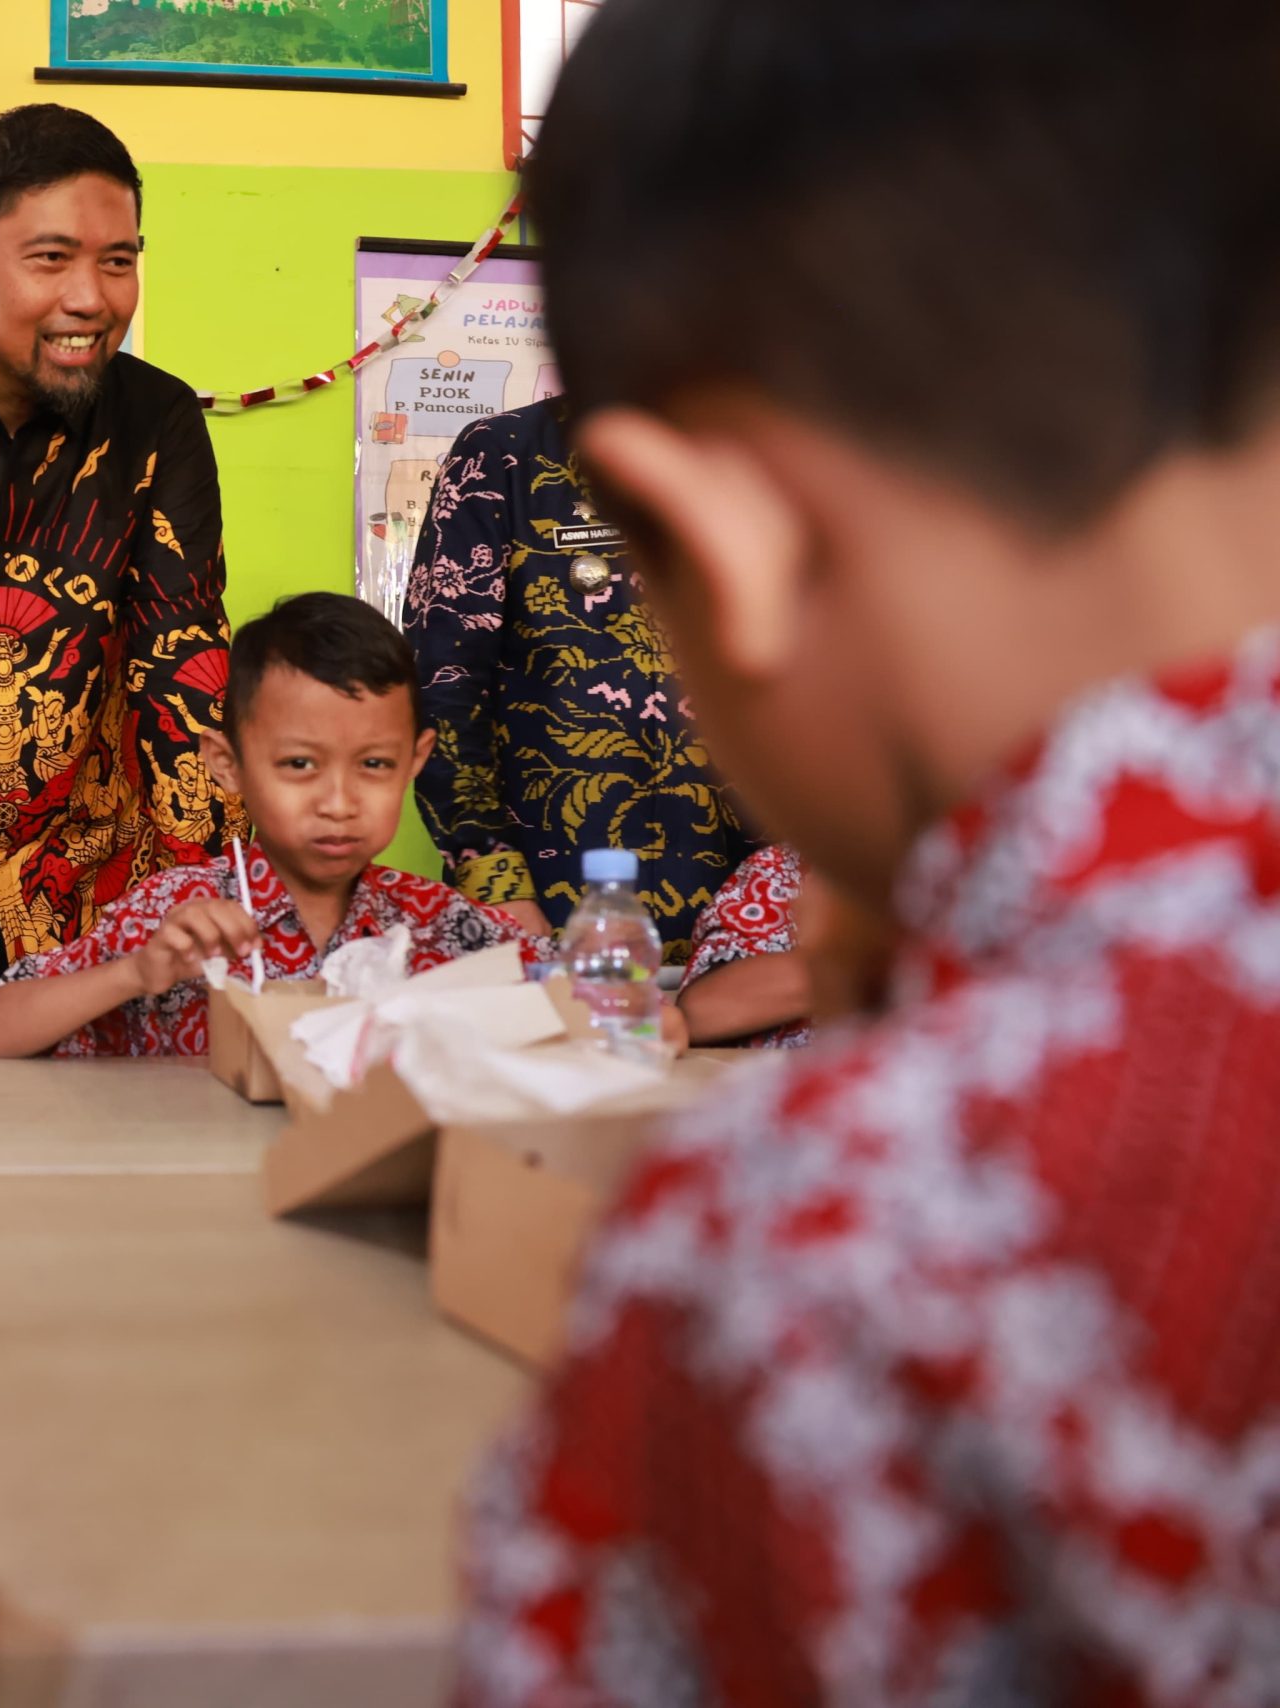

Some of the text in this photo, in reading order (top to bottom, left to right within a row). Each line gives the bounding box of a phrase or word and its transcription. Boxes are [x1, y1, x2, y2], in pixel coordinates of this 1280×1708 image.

[467, 335, 500, 345] Kelas
[505, 337, 519, 346] IV
[420, 368, 476, 383] SENIN
[420, 387, 471, 399] PJOK
[395, 401, 495, 415] P. Pancasila
[561, 531, 589, 541] ASWIN
